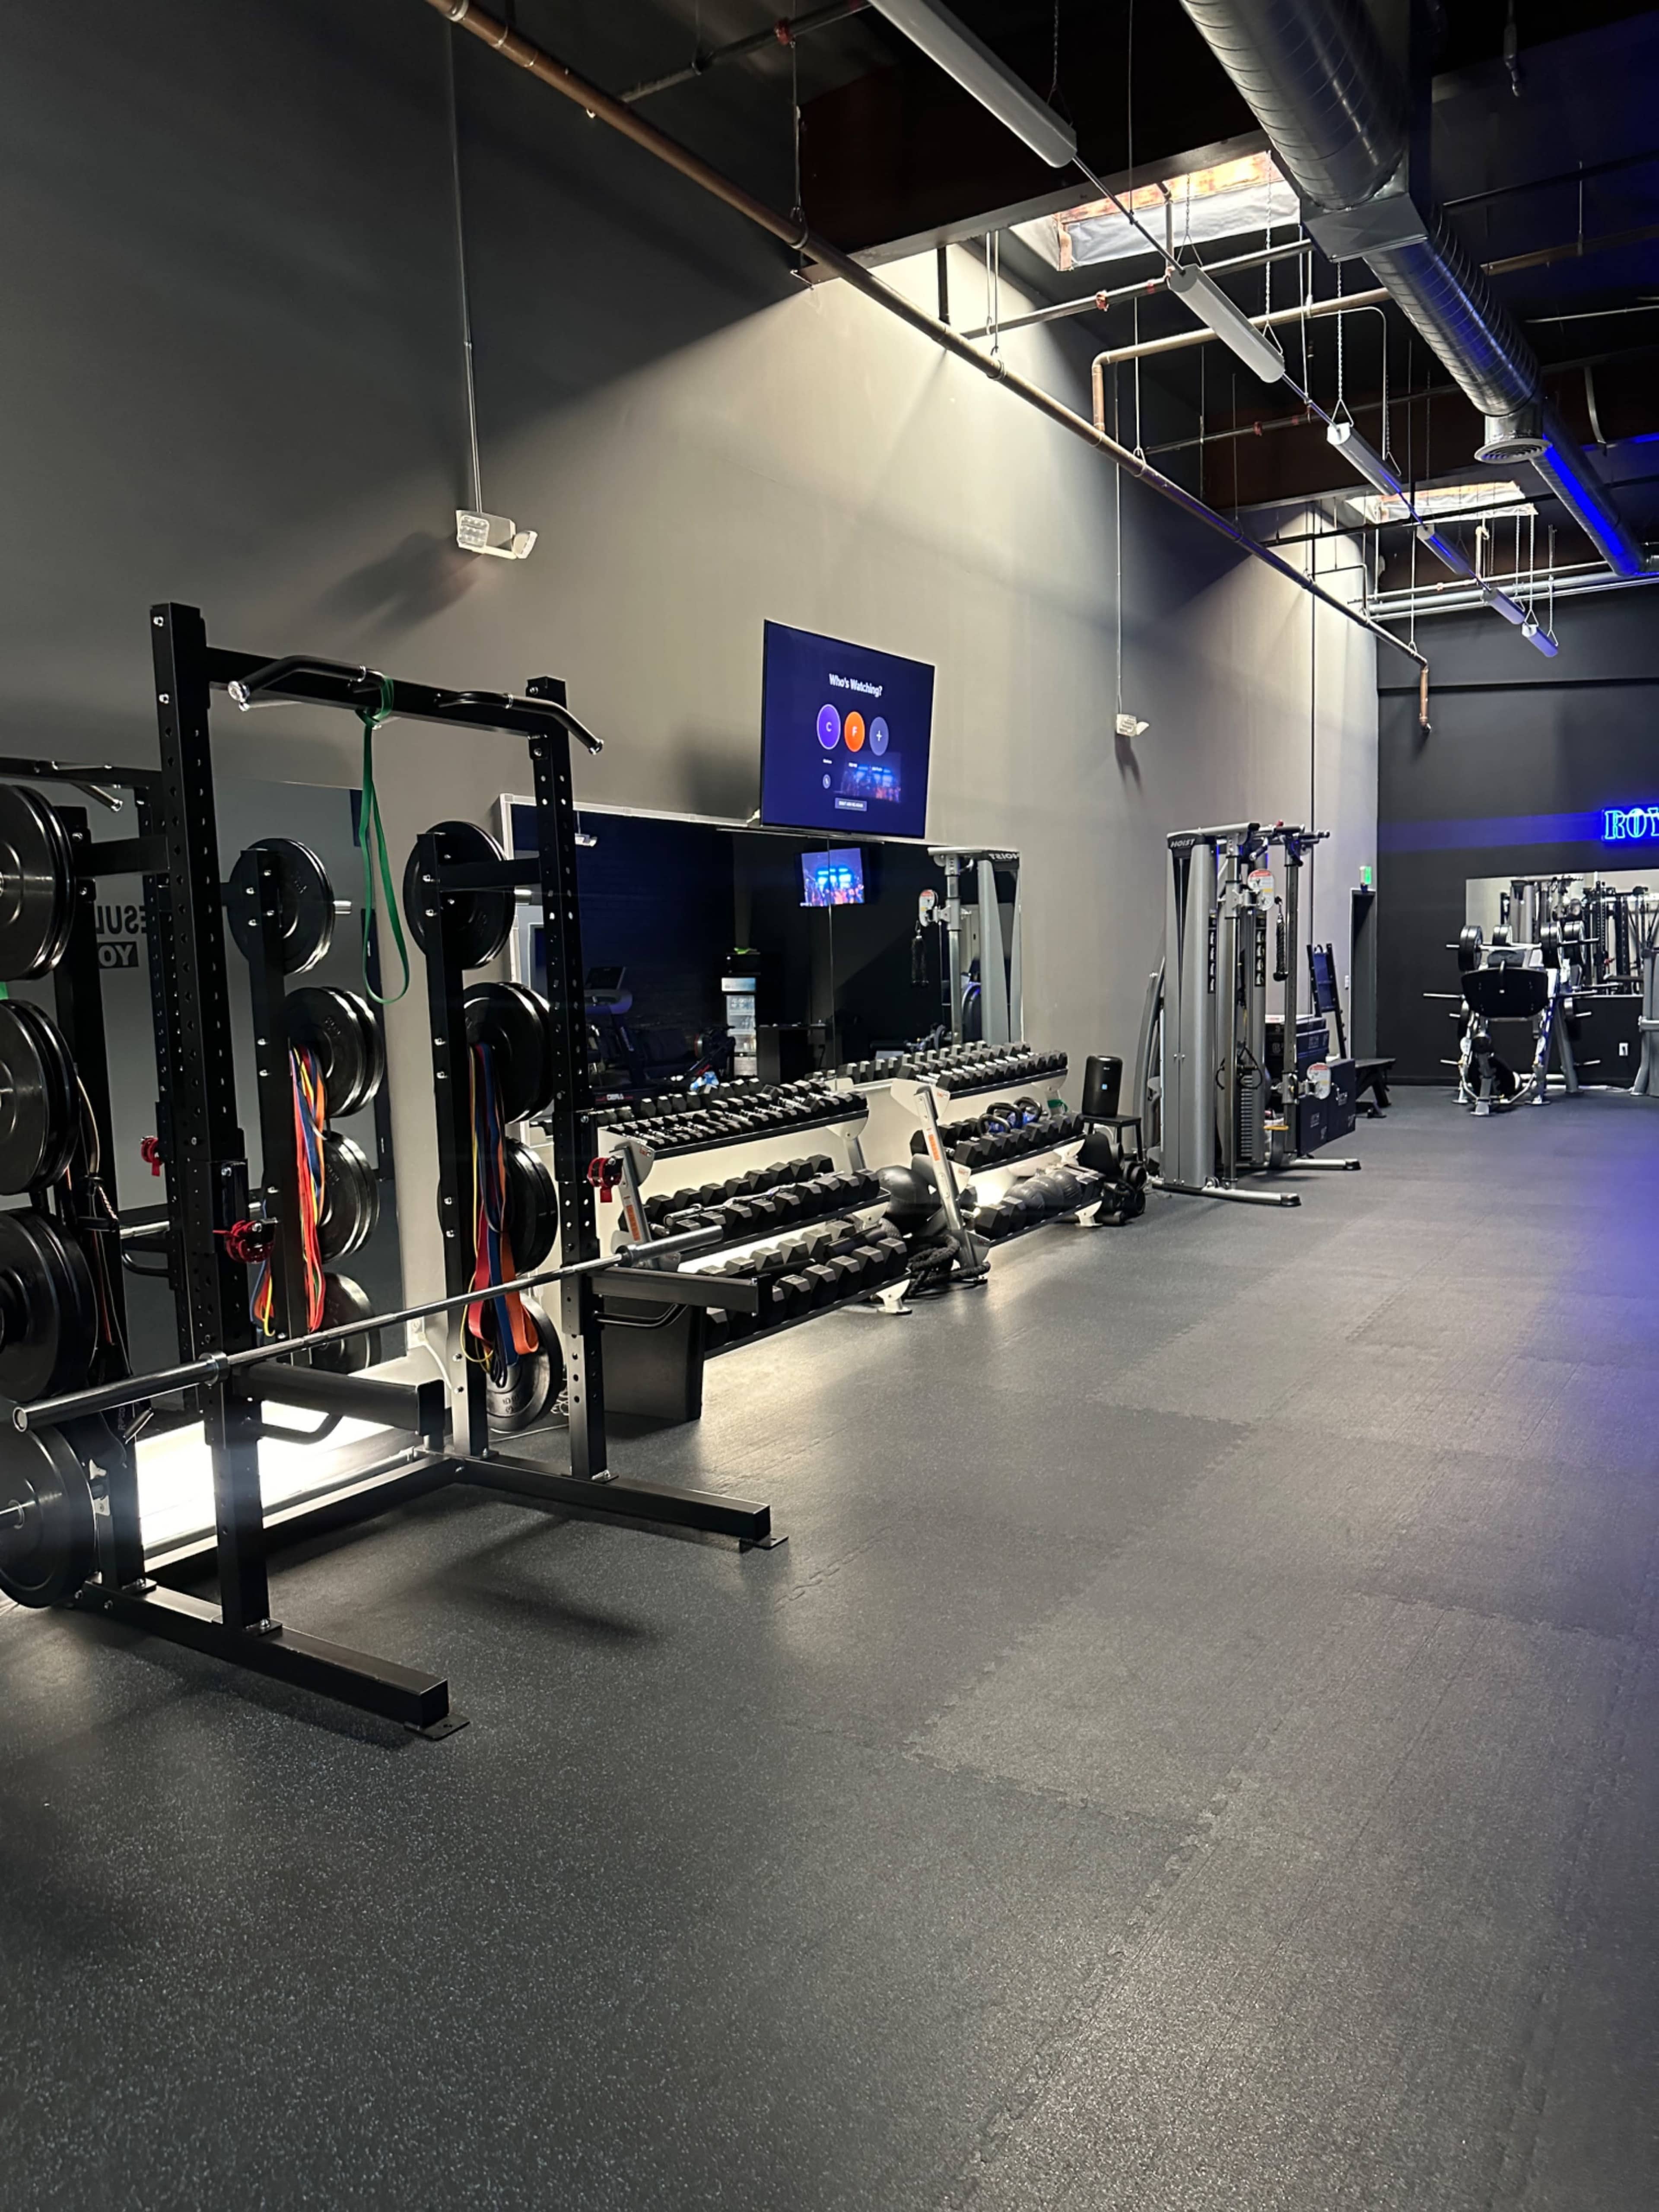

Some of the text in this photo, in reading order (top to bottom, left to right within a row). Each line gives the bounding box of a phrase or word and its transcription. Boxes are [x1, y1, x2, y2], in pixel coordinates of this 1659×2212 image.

[829, 673, 883, 698] Who's Watching?
[826, 721, 832, 732] C
[852, 726, 858, 737] F
[1170, 838, 1195, 848] HOIST
